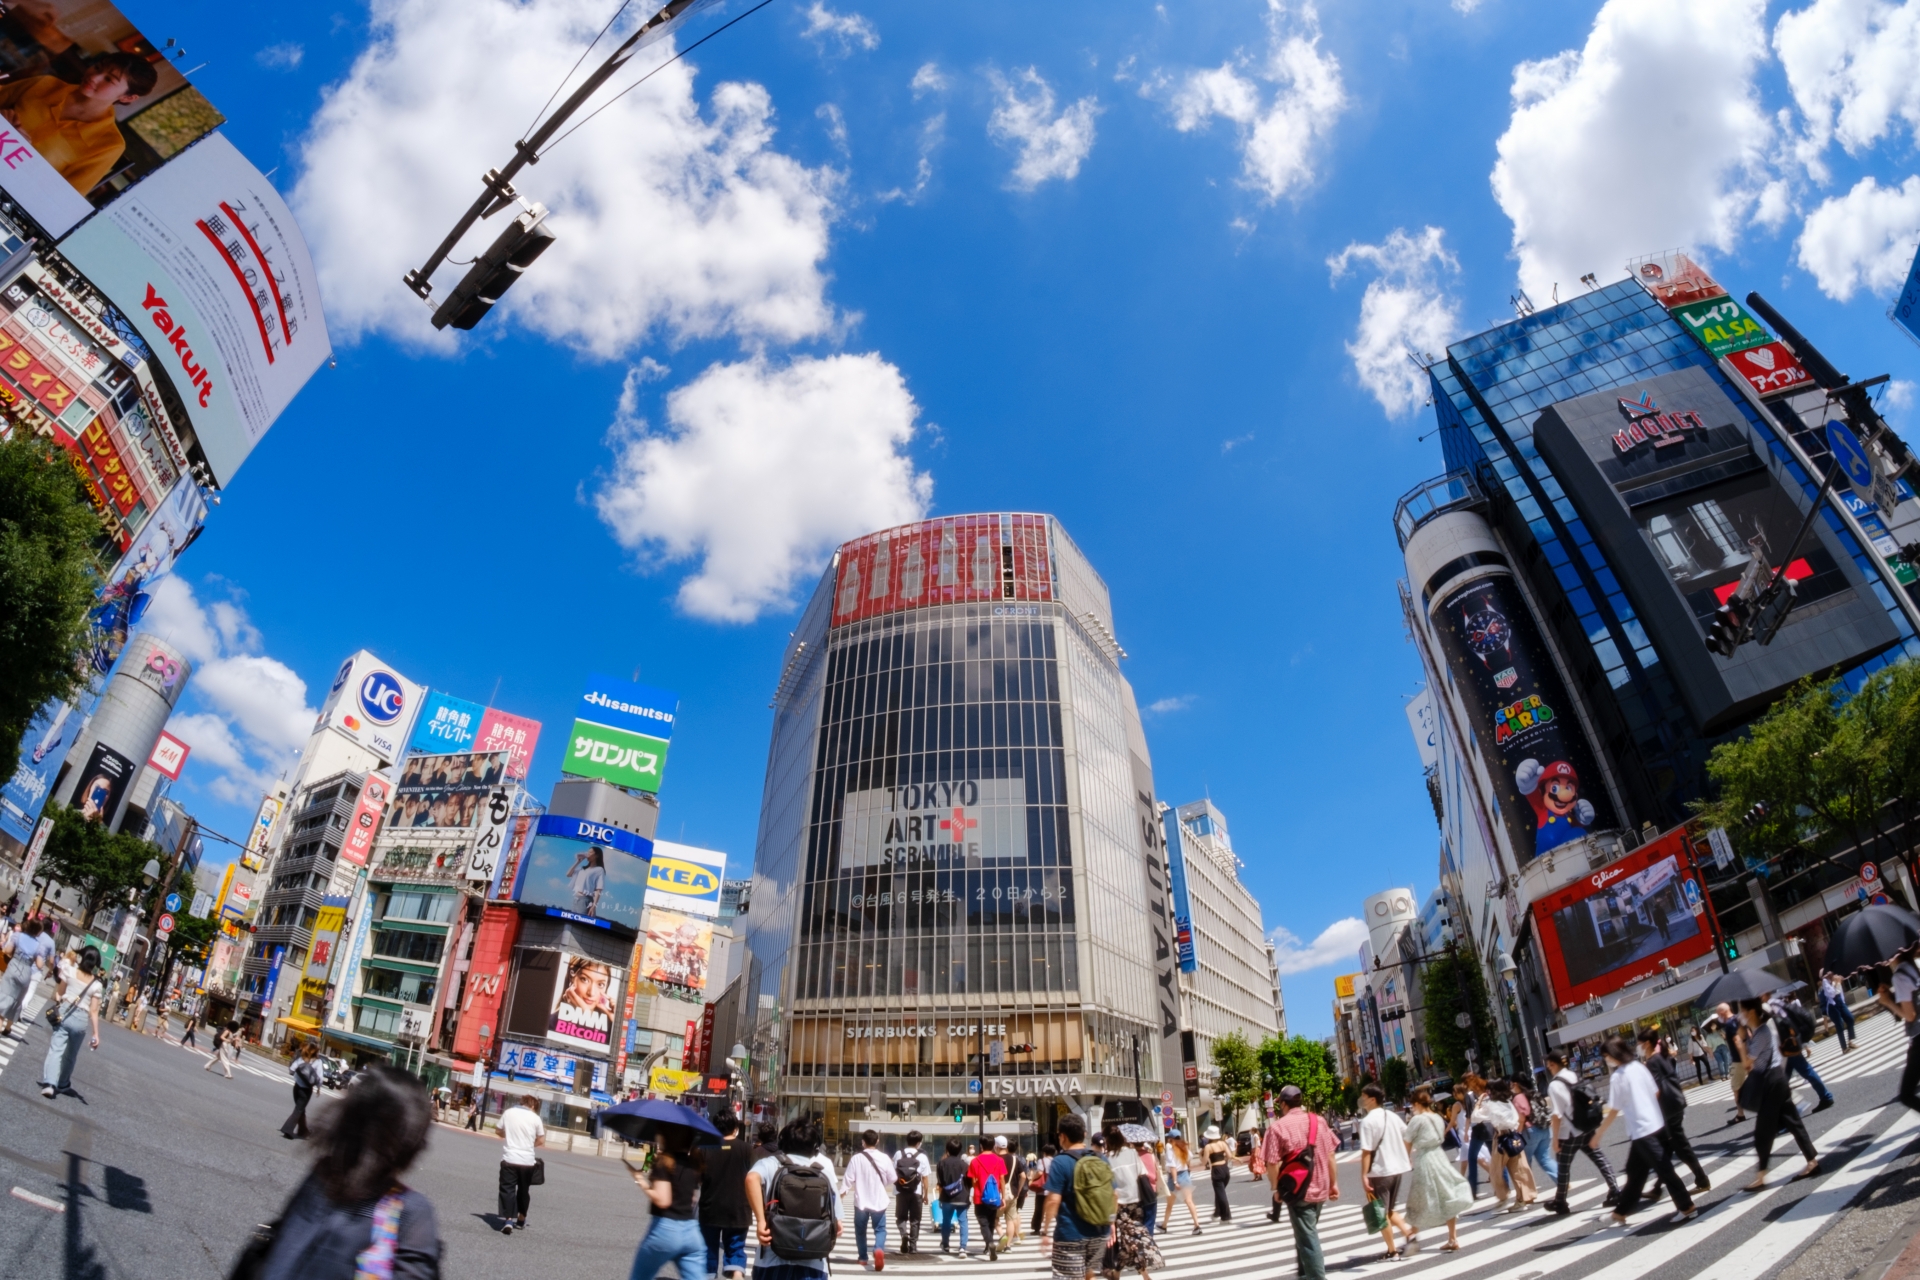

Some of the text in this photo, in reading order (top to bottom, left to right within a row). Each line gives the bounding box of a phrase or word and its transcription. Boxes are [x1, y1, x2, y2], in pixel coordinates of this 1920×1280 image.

[7, 284, 29, 303] 9F
[206, 213, 283, 352] 睡眠の質向上
[1657, 276, 1718, 297] アコム
[1682, 301, 1740, 328] レイク
[48, 320, 101, 370] しゃぶ葉
[140, 281, 214, 409] Yakult
[1702, 317, 1764, 344] ALSA
[1750, 367, 1806, 391] アイフル
[12, 398, 56, 438] ガスト
[1612, 409, 1708, 453] MAGNET
[85, 418, 136, 506] コンタクト
[99, 504, 125, 544] ガスト
[994, 607, 1038, 616] QFRONT
[146, 645, 182, 687] 109
[1494, 668, 1516, 683] TAG
[363, 675, 402, 715] UC
[583, 690, 674, 723] Hisamitsu
[1496, 695, 1541, 725] SUPER
[435, 706, 472, 729] 龍角散
[1496, 706, 1555, 745] MARIO
[373, 734, 392, 753] VISA
[490, 722, 528, 745] 龍角散
[574, 735, 658, 776] サロンパス
[887, 780, 979, 812] TOKYO
[471, 786, 510, 879] もんじゃ
[577, 821, 615, 843] DHC
[884, 814, 940, 845] ART
[884, 842, 979, 865] SCRAMBLE
[650, 864, 712, 891] KEA
[1591, 868, 1624, 888] Glico
[1138, 788, 1178, 1040] TSUTAYA
[1176, 915, 1194, 963] SEIBU
[555, 1020, 607, 1044] Bitcoin
[558, 1002, 609, 1032] DMM
[700, 1007, 714, 1047] カラオケ
[846, 1024, 1007, 1039] STARBUCKS COFFEE
[987, 1076, 1082, 1096] TSUTAYA
